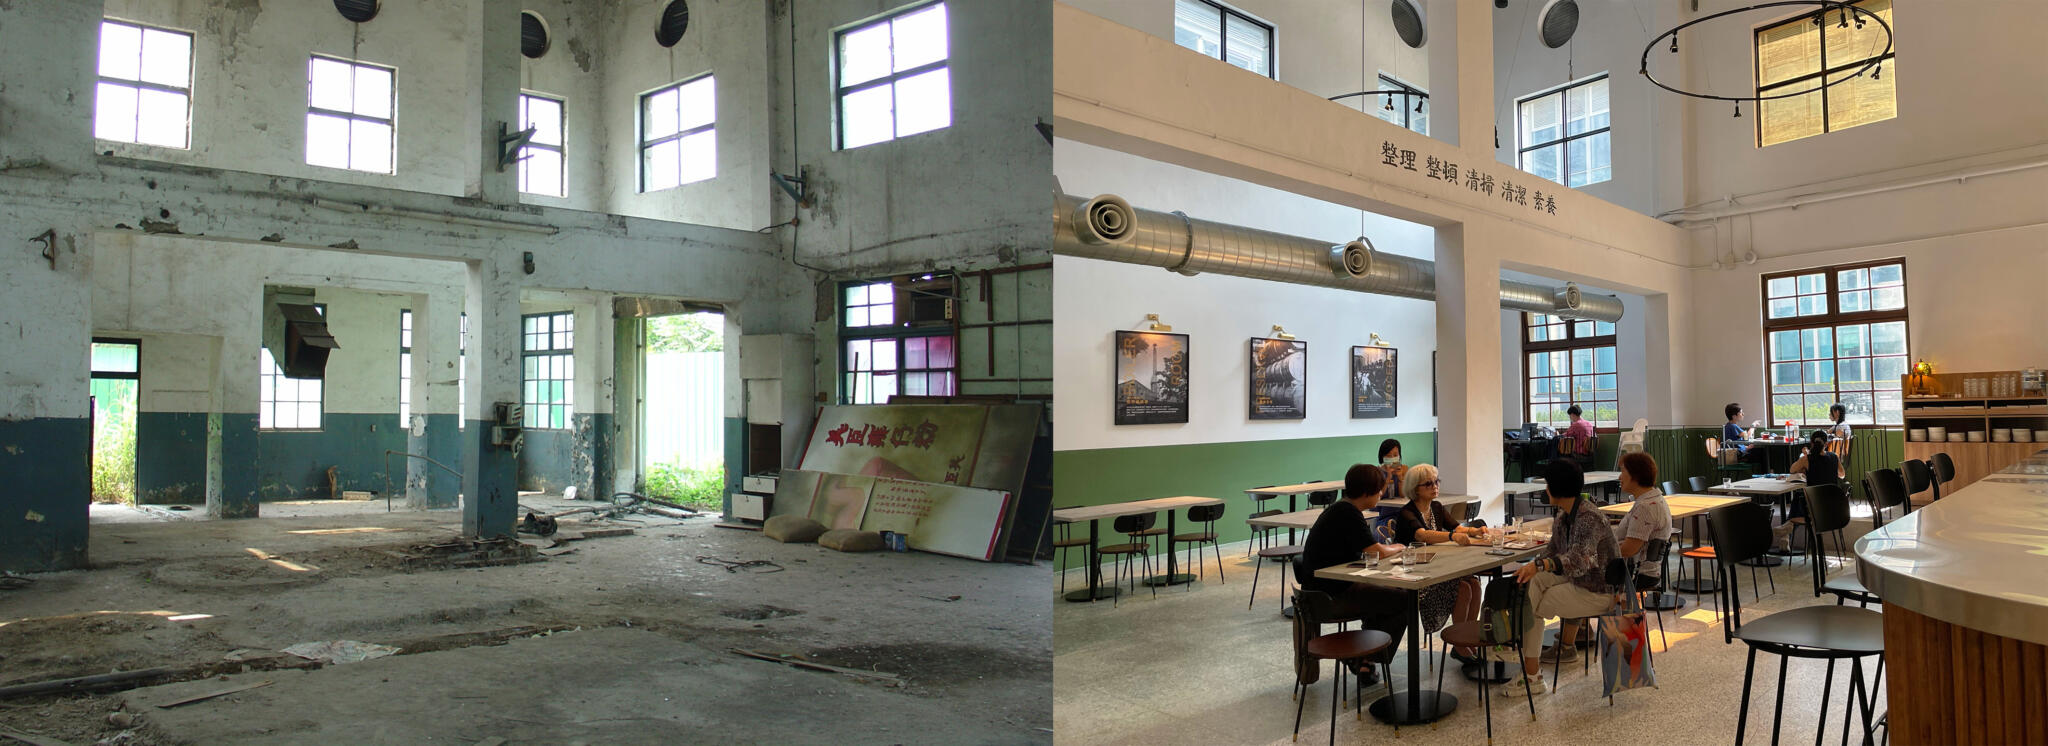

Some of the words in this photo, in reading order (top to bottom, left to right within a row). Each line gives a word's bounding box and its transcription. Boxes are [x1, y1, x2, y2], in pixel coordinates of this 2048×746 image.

[1380, 140, 1418, 172] 整理
[1425, 154, 1459, 186] 整頓
[1465, 168, 1495, 197] 清掃
[1501, 181, 1527, 206] 清潔
[1533, 190, 1558, 216] 素養
[1170, 340, 1183, 386] ROOM
